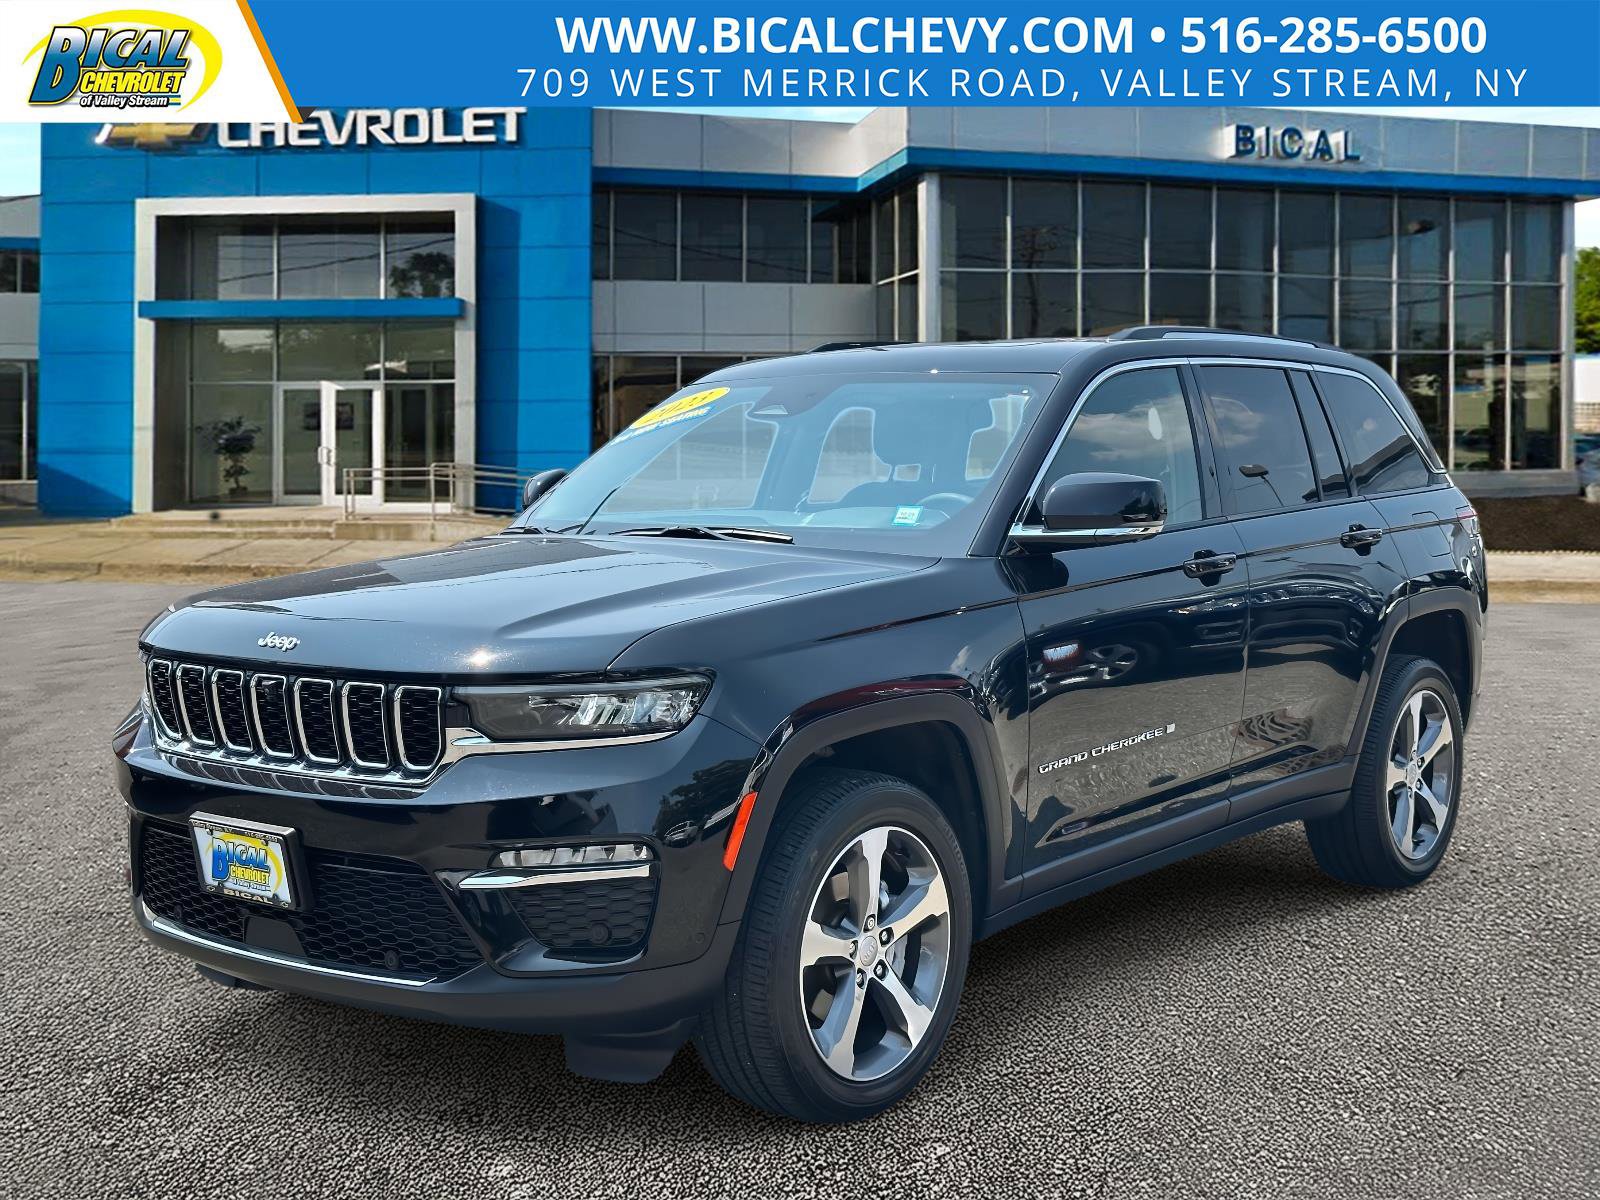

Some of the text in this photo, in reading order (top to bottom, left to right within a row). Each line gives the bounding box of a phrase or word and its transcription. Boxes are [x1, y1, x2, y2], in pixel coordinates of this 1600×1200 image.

[1234, 124, 1361, 161] BICAL
[257, 631, 299, 653] Jeep
[1038, 727, 1165, 774] GRAND CHEROKEE
[211, 836, 270, 881] BICAL
[230, 864, 271, 885] CHEVROLET
[223, 888, 274, 905] BICAL
